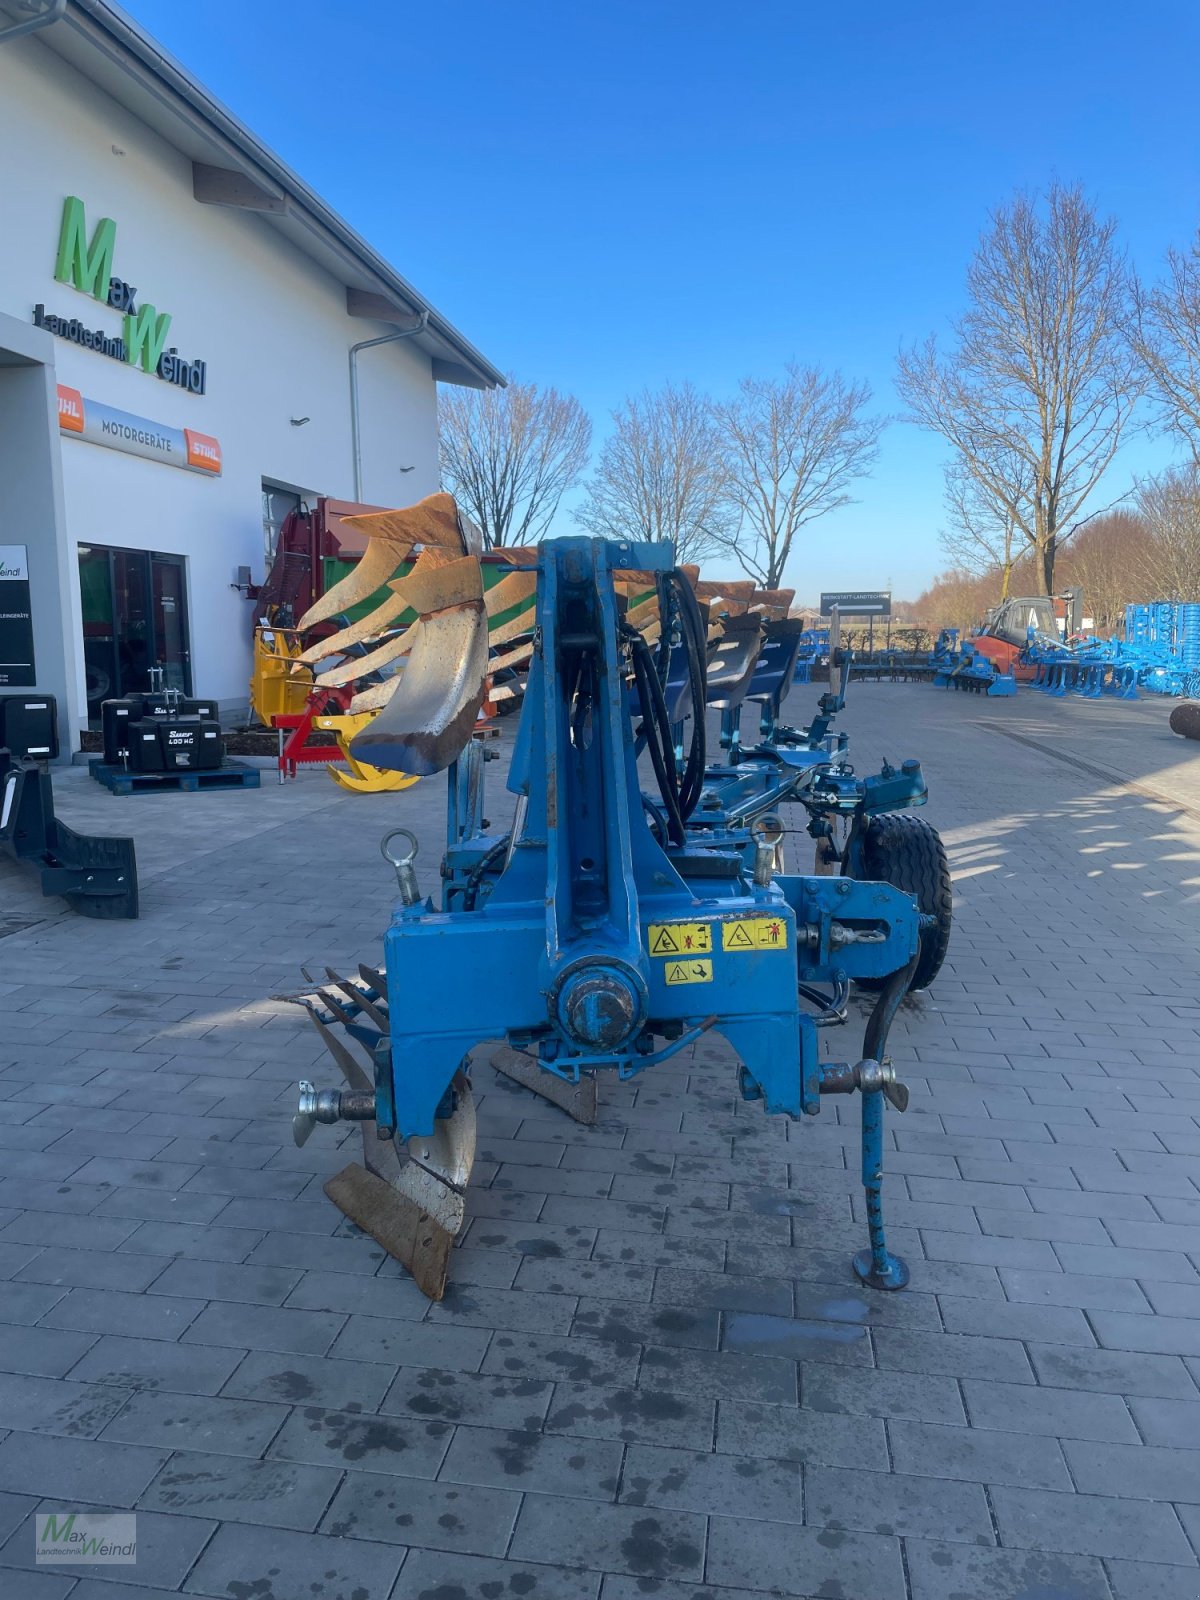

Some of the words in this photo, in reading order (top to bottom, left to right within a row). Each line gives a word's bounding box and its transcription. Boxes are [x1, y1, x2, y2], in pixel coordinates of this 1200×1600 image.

[54, 195, 138, 316] Max
[33, 303, 128, 362] Landtechnik
[123, 303, 206, 395] Weindl
[58, 397, 80, 418] IHL
[102, 420, 172, 452] MOTORGERÄTE
[192, 442, 219, 461] STIHL
[168, 730, 193, 738] Suer
